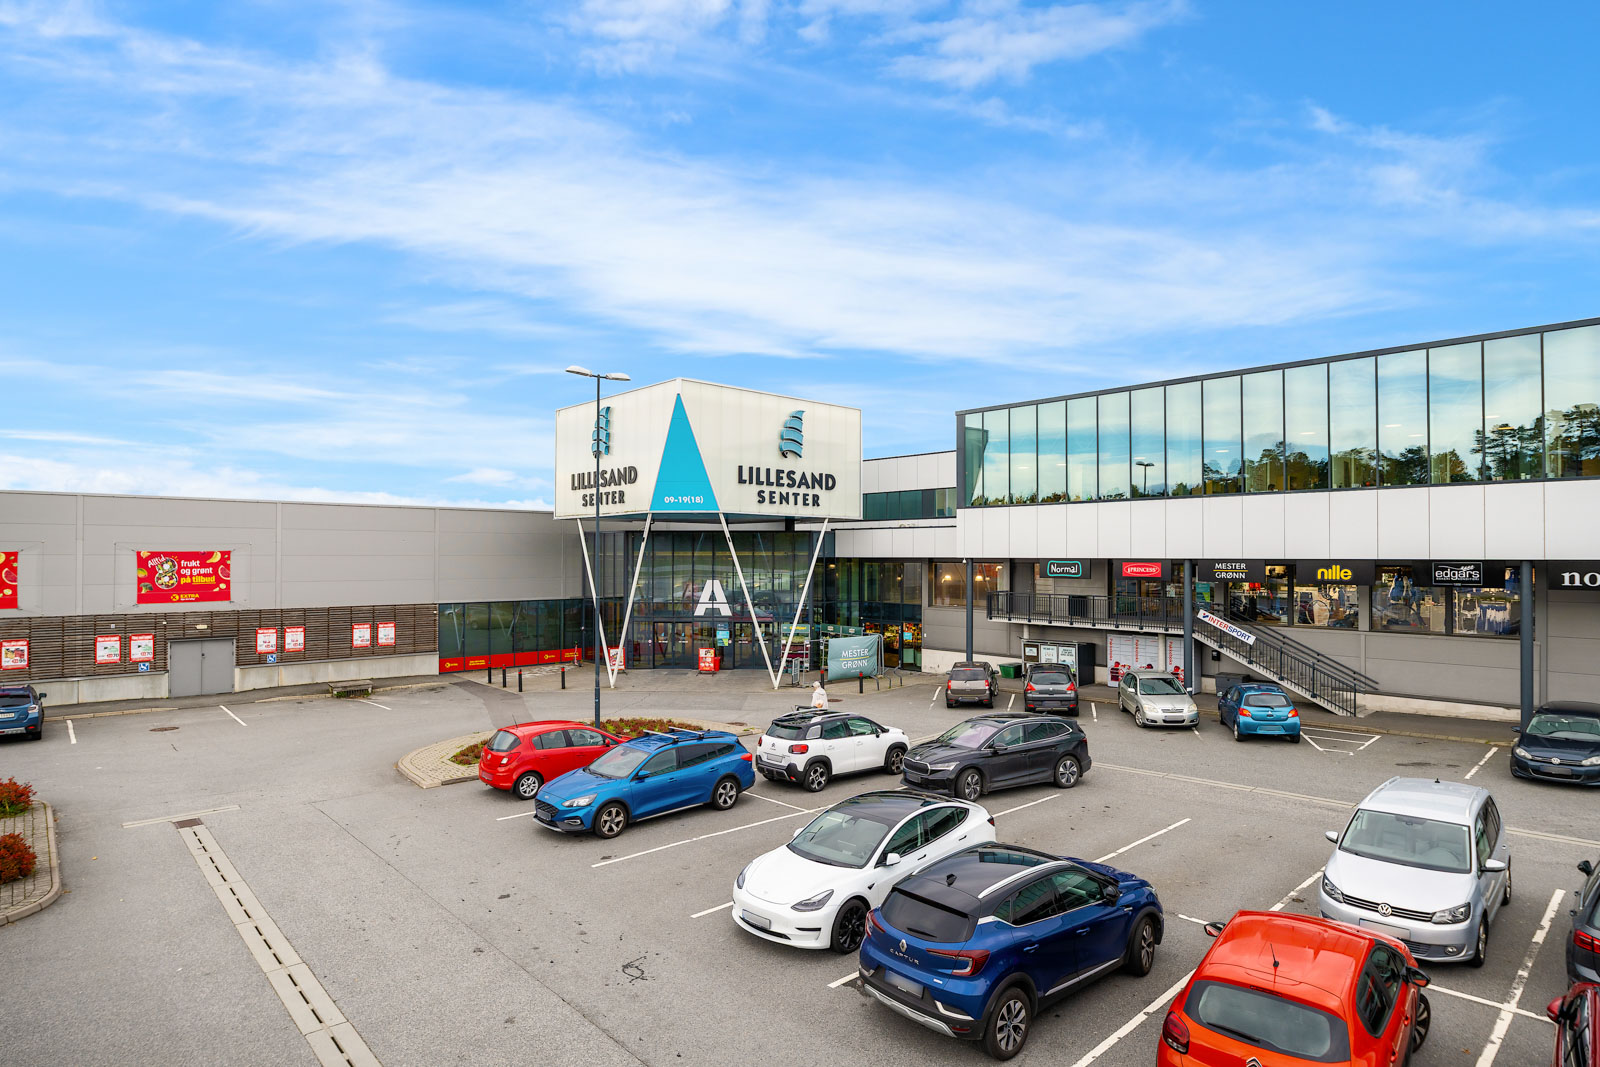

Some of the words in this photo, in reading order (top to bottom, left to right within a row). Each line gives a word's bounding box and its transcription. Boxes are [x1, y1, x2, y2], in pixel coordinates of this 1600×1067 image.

[737, 465, 837, 491] LILLESAND
[664, 495, 704, 505] 09-19(18)
[757, 489, 821, 507] SENTER
[147, 554, 167, 569] Alltid
[181, 559, 200, 567] frukt
[1215, 562, 1247, 570] MESTER
[180, 568, 191, 576] og
[192, 567, 213, 576] grønt
[1050, 564, 1078, 574] Normal
[1317, 564, 1352, 580] nille
[1435, 568, 1480, 581] edgars
[180, 576, 191, 585] på
[192, 575, 216, 584] tilbud
[1215, 571, 1246, 579] GRØNN
[1561, 571, 1600, 587] no
[694, 579, 733, 616] A
[1207, 615, 1251, 641] INTERSPORT
[841, 648, 869, 658] MESTER
[841, 659, 868, 669] GRØNN
[889, 948, 920, 965] CAPTUR
